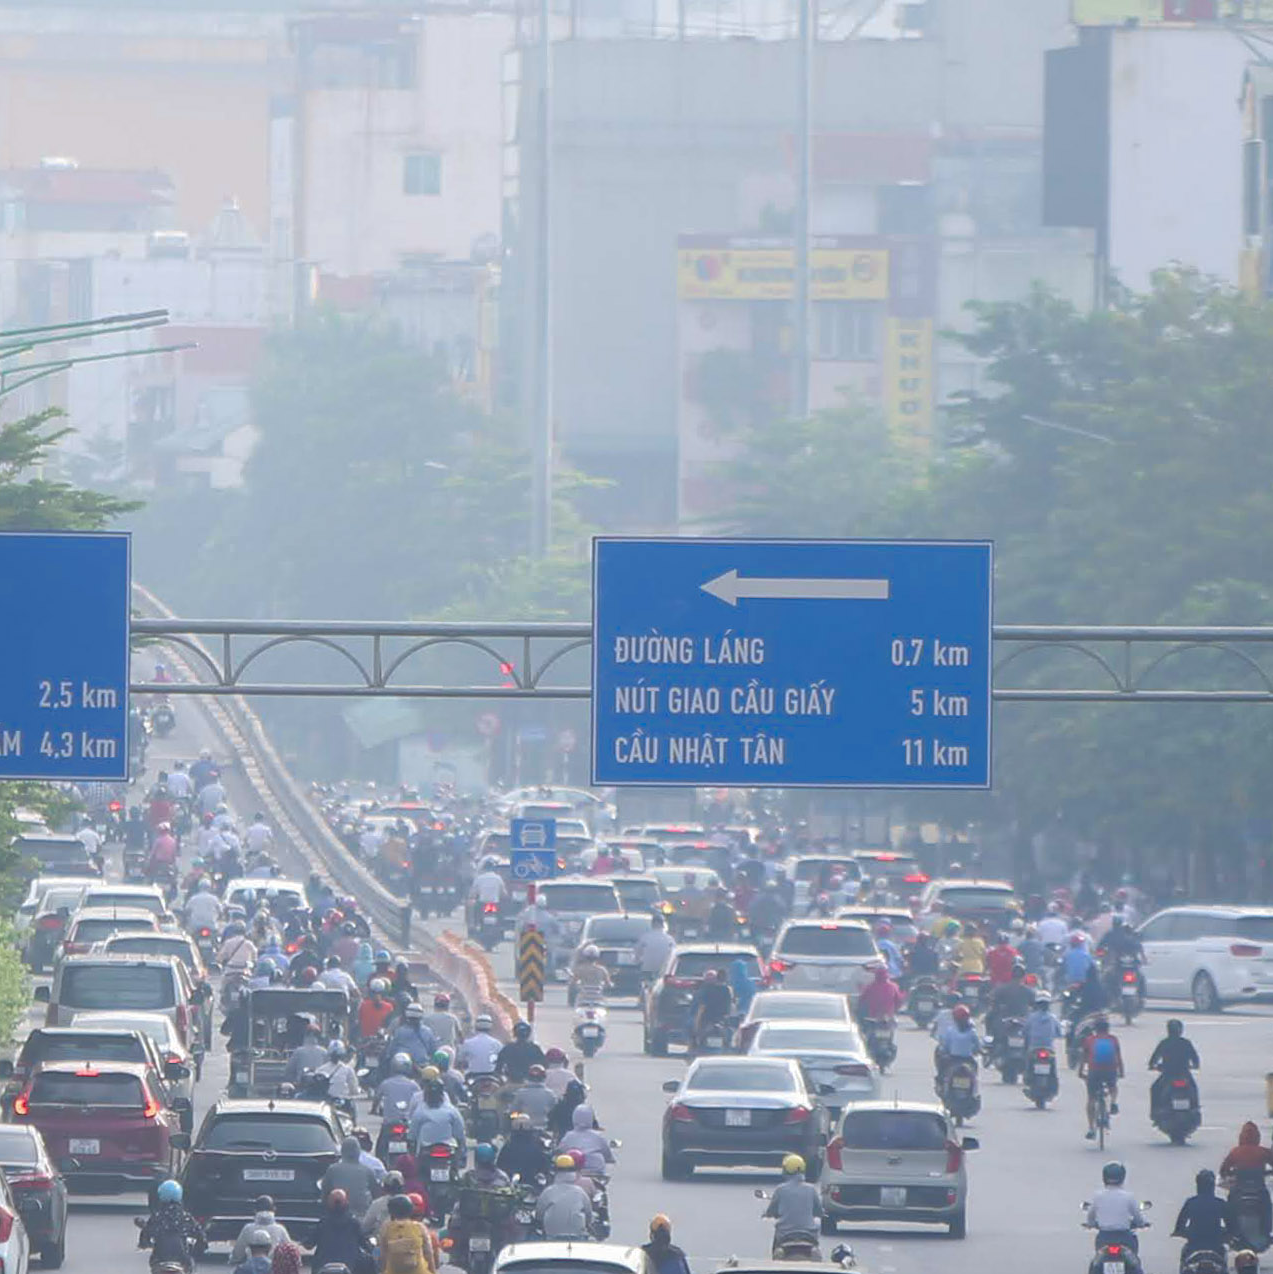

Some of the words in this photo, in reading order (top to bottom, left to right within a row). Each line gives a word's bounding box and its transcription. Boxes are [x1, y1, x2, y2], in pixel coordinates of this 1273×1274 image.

[614, 628, 693, 664] ĐƯỜNG
[704, 629, 764, 664] LÁNG
[934, 639, 969, 666] km
[82, 681, 117, 708] km
[615, 678, 660, 714] NÚT
[668, 687, 720, 714] GIAO
[730, 678, 774, 714] CẦU
[785, 679, 835, 715] GIẤY
[911, 689, 924, 716] 5
[933, 689, 968, 716] km
[81, 731, 116, 758] km
[615, 728, 659, 764] CẦU
[669, 732, 729, 767] NHẬT
[740, 733, 784, 764] TÂN
[903, 739, 923, 765] 11
[933, 739, 968, 766] km
